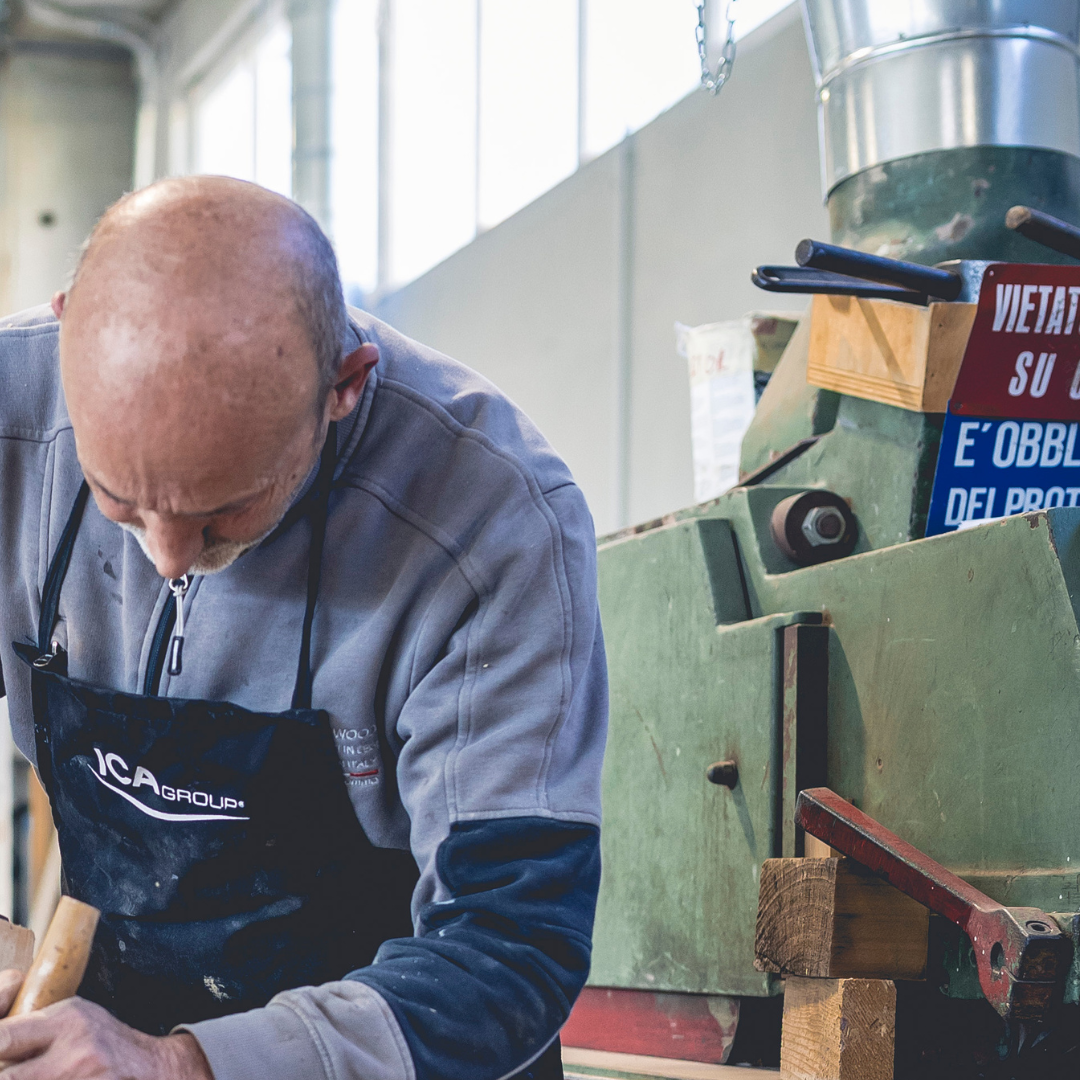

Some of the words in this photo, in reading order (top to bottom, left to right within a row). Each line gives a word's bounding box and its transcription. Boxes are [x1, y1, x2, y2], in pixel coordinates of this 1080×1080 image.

[992, 283, 1080, 335] VIETAT
[1008, 350, 1057, 398] SU
[93, 747, 161, 796] ICA
